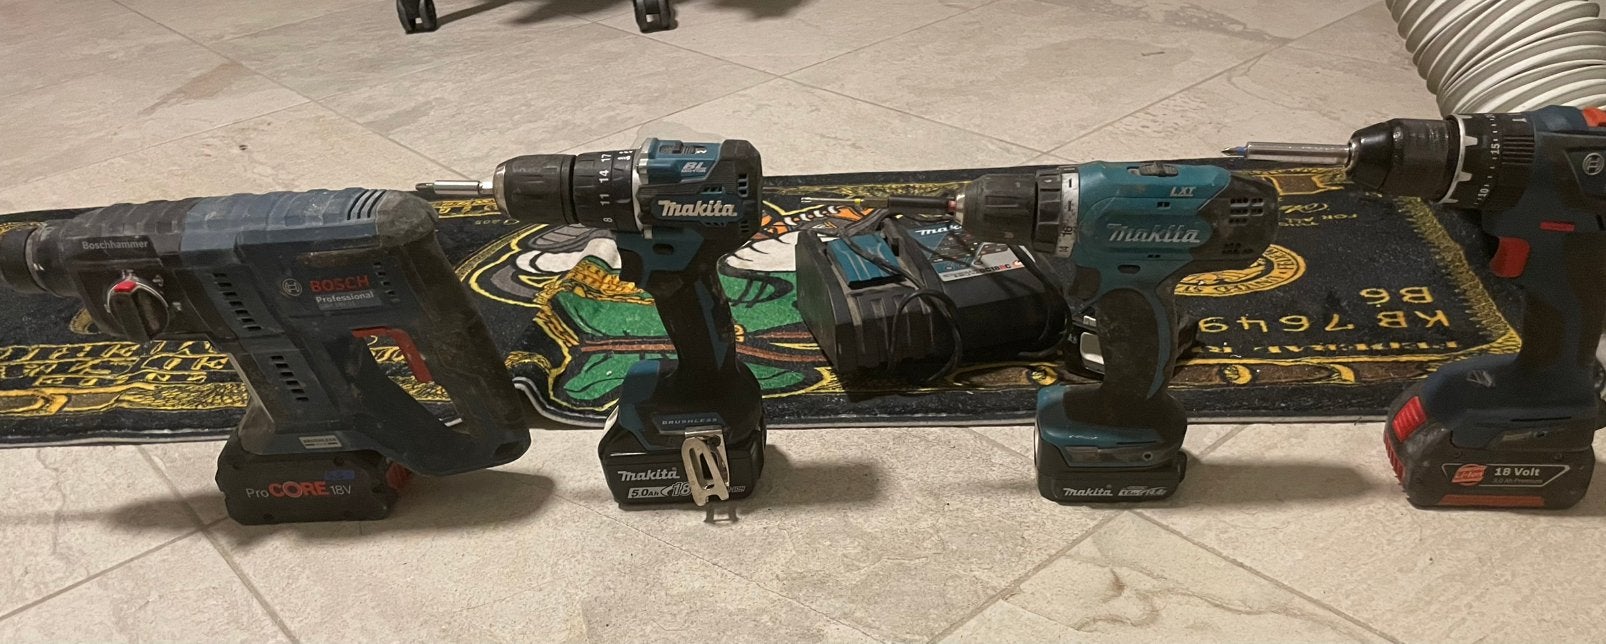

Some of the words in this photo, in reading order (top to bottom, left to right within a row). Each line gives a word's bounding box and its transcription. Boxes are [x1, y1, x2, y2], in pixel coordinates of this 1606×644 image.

[1491, 143, 1501, 155] 15
[601, 153, 611, 163] 17
[681, 161, 707, 171] BL
[599, 170, 610, 183] 14
[1169, 186, 1197, 197] LXT
[82, 240, 149, 250] Boschhammer
[310, 275, 370, 293] BOSCH
[315, 290, 375, 303] Professional
[1359, 286, 1435, 305] B6
[1376, 308, 1451, 329] KB
[1494, 467, 1511, 476] 18
[1514, 467, 1540, 476] Volt
